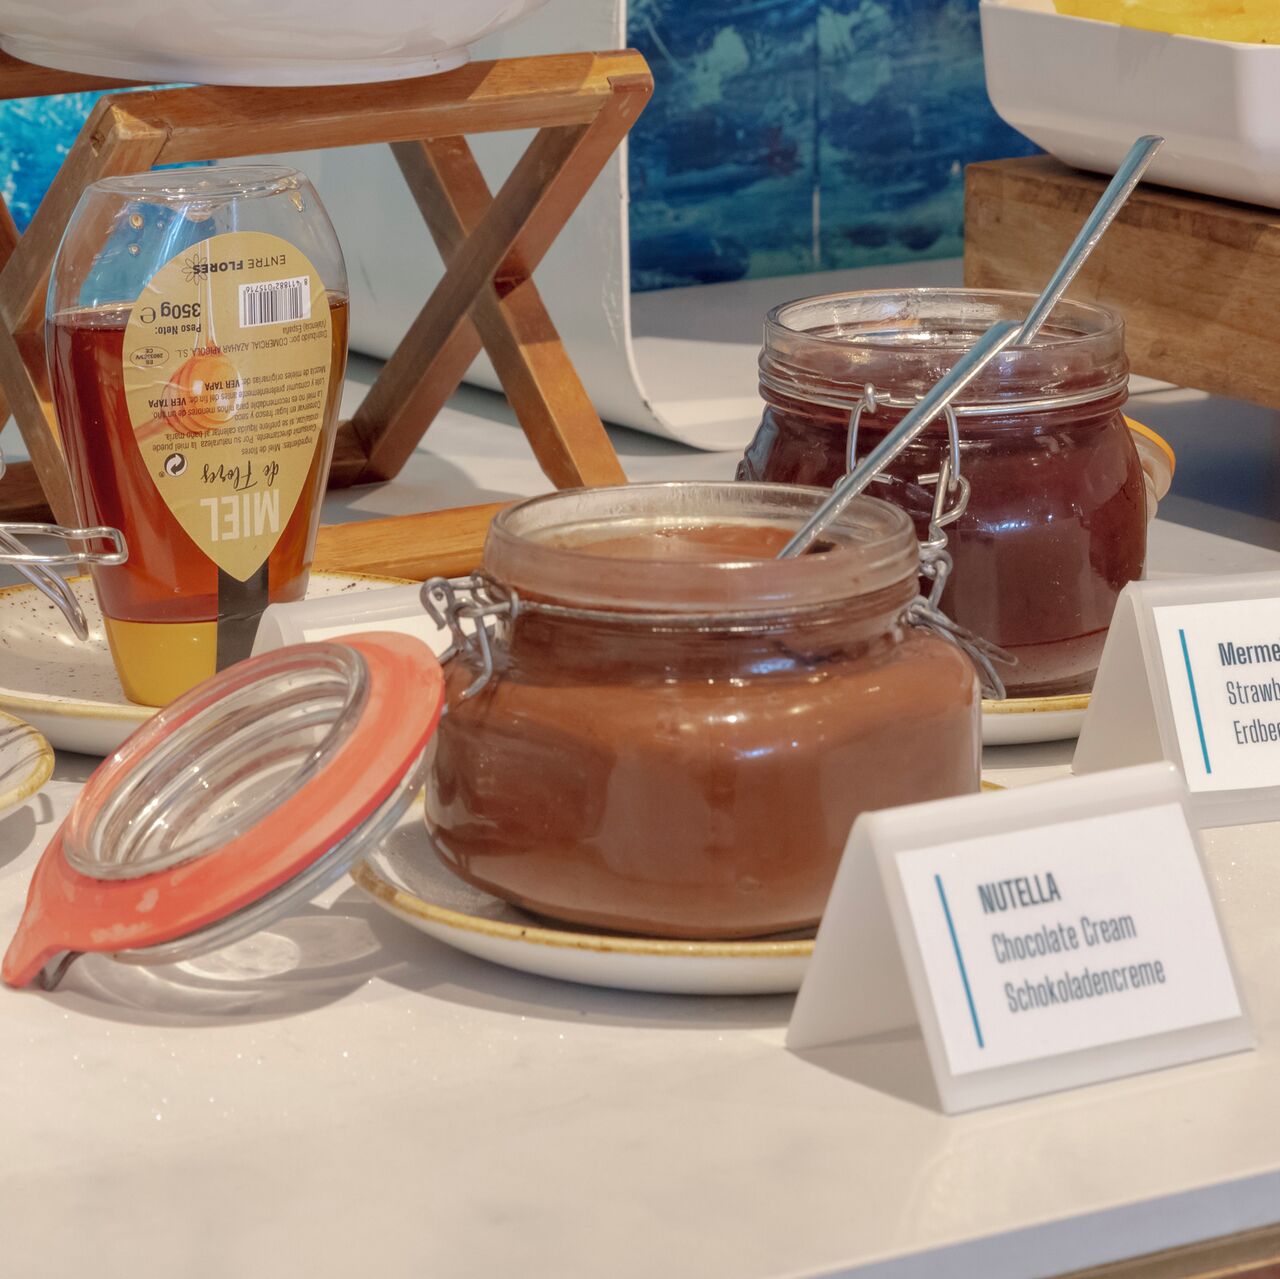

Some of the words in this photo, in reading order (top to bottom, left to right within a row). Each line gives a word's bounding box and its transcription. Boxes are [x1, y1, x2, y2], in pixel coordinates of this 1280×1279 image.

[248, 254, 286, 269] ENTRE
[192, 260, 243, 274] FLORES
[160, 302, 201, 319] 350g
[155, 326, 178, 334] Neto:
[181, 324, 201, 332] Peso
[223, 343, 249, 352] AZAHAR
[251, 337, 288, 350] COMERCIAL
[285, 371, 302, 380] mieles
[303, 368, 309, 376] de
[204, 381, 223, 390] TAPA
[225, 379, 240, 389] VER
[148, 399, 168, 408] TAPA
[170, 397, 186, 407] VER
[188, 408, 215, 416] menores
[256, 411, 273, 419] fresco
[152, 443, 173, 453] puede
[175, 442, 190, 451] miel
[201, 460, 257, 492] Flores
[263, 461, 279, 487] de
[200, 488, 279, 542] MIEL
[978, 872, 1062, 915] NUTELLA
[992, 922, 1079, 964] Chocolate
[1081, 914, 1137, 947] Cream
[1004, 959, 1166, 1014] Schokoladencreme
